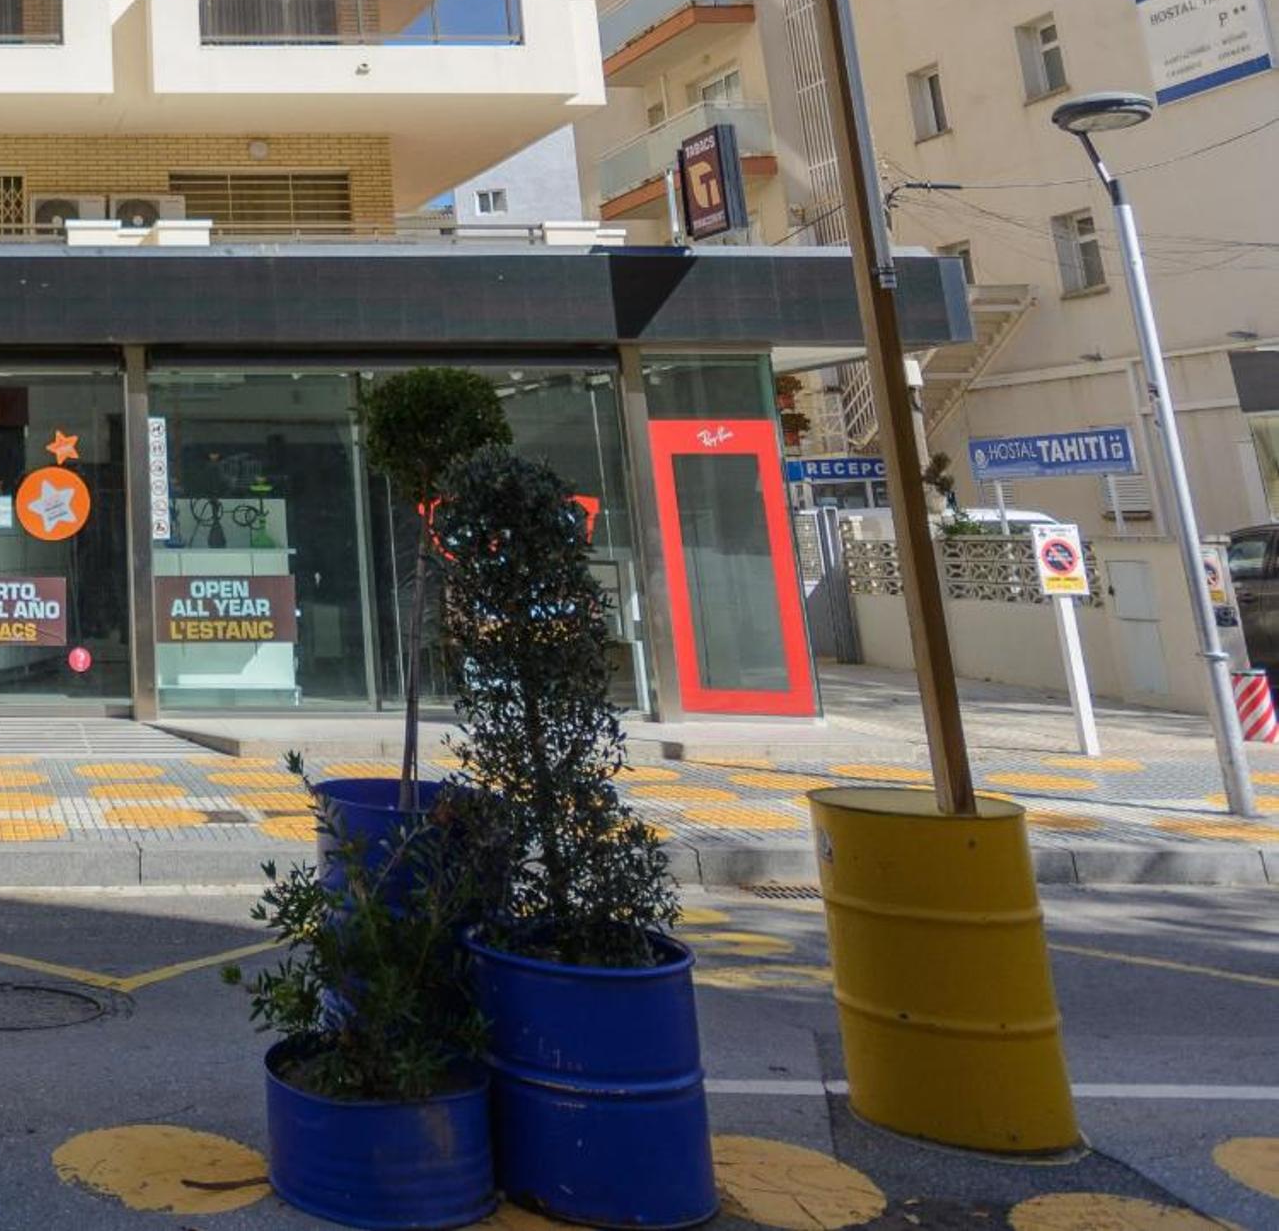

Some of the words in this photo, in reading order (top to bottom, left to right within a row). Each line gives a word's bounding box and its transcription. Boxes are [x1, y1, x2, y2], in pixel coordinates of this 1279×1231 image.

[1150, 0, 1197, 26] HOSTAL
[685, 134, 716, 159] TABACS
[988, 441, 1038, 461] HOSTAL
[1037, 436, 1108, 463] TAHITI
[806, 461, 887, 475] RECEPC
[190, 580, 250, 598] OPEN
[170, 599, 210, 617] ALL
[214, 599, 270, 617] YEAR
[171, 621, 275, 640] L'ESTANC
